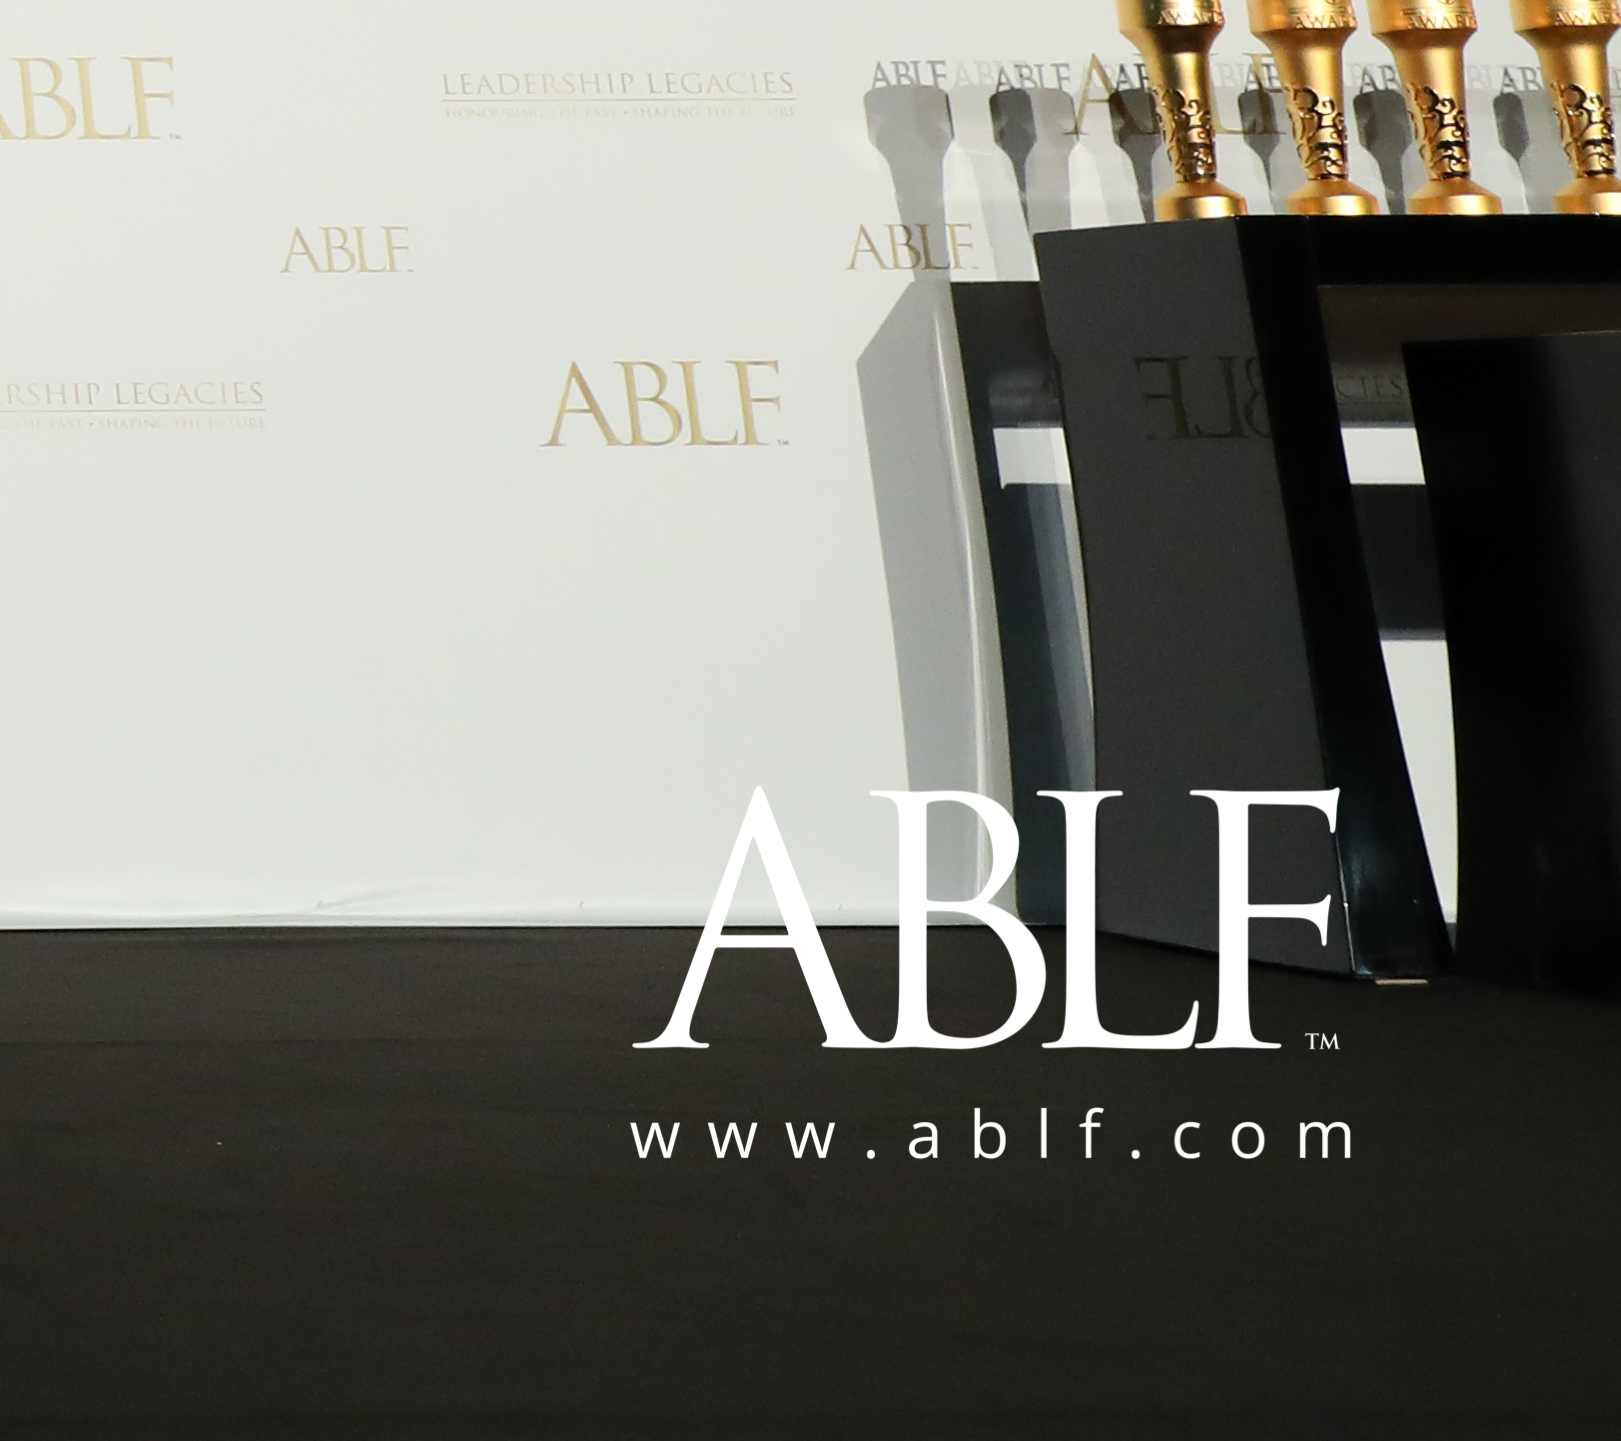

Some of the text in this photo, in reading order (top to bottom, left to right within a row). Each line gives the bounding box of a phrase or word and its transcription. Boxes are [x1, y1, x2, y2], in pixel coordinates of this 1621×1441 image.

[442, 72, 793, 95] LEADERSHIP LEGACIES
[281, 226, 409, 273] ABLF
[847, 223, 972, 270] ABLF
[114, 381, 263, 405] LEGACIES
[540, 360, 780, 447] ABLF
